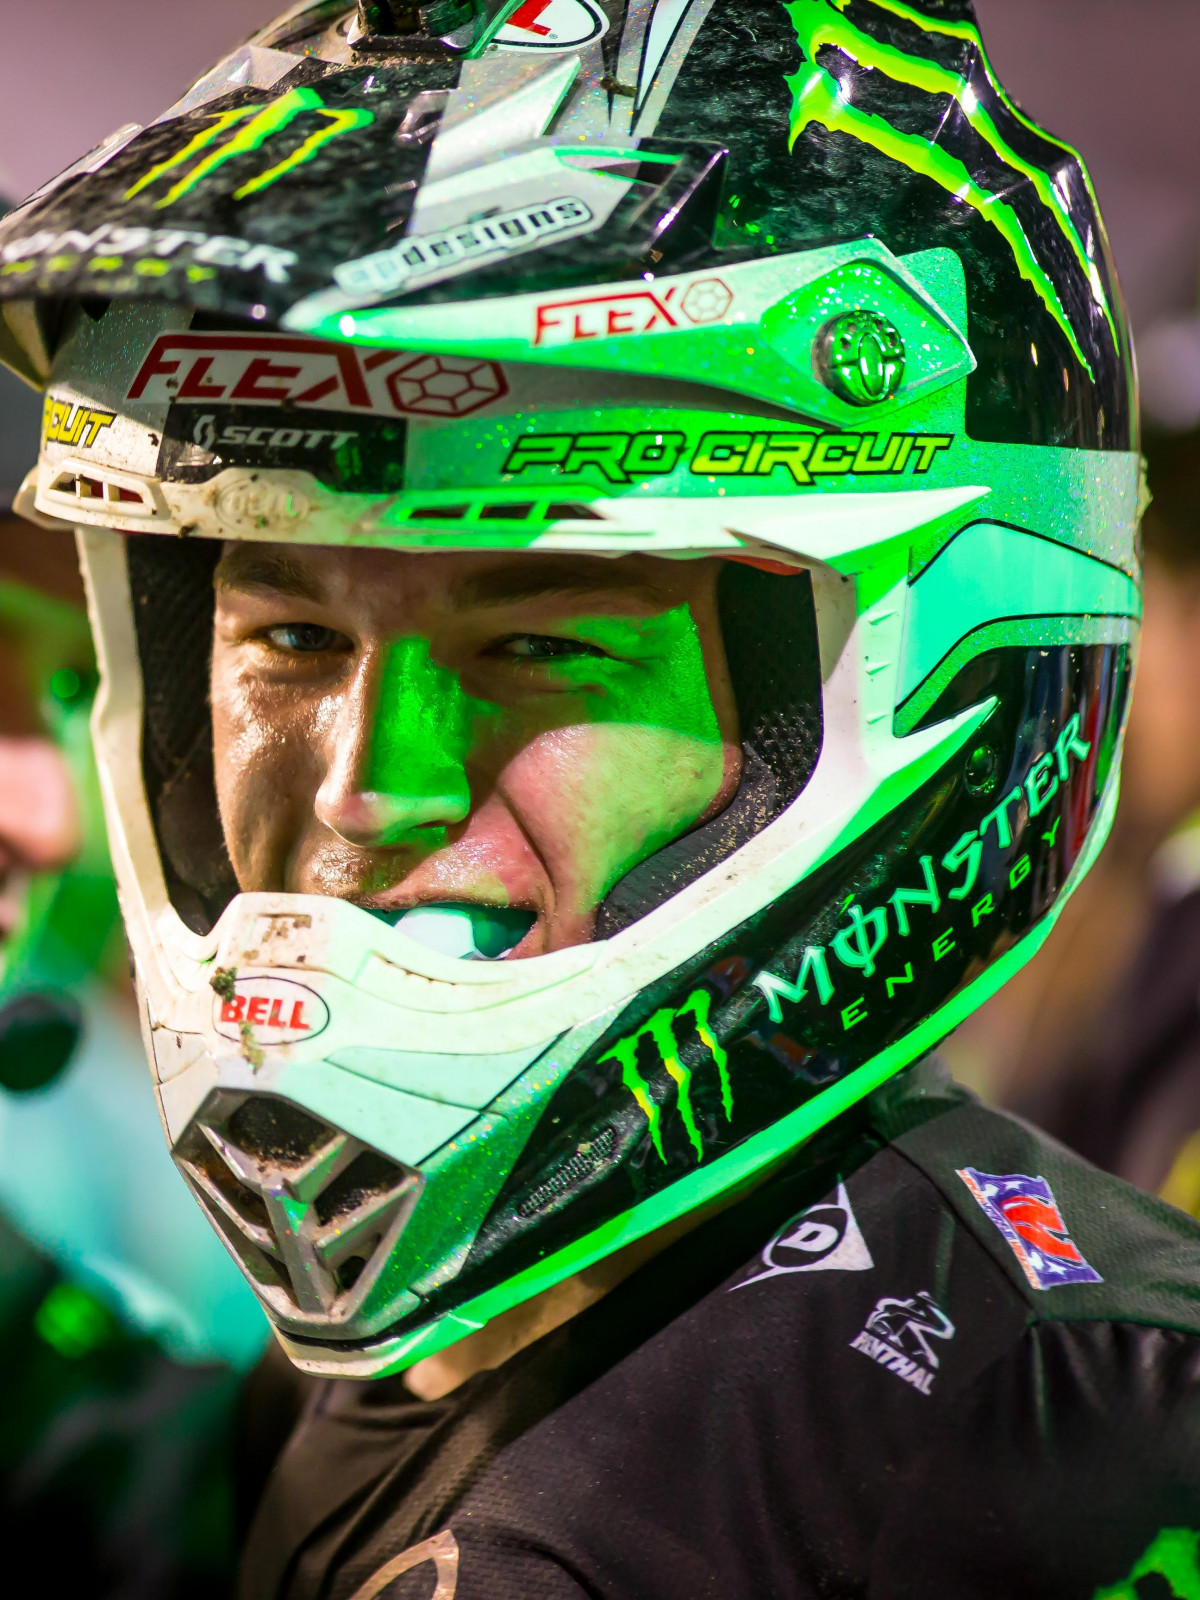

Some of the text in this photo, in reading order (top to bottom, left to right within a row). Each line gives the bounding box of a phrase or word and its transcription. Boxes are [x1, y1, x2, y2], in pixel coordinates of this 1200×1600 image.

[532, 286, 680, 346] FLEX
[126, 333, 398, 407] FLEX
[216, 426, 359, 449] SCOTT
[501, 430, 955, 486] PRO CIRCUIT
[840, 815, 1061, 1032] ENERGY
[220, 994, 311, 1031] BELL
